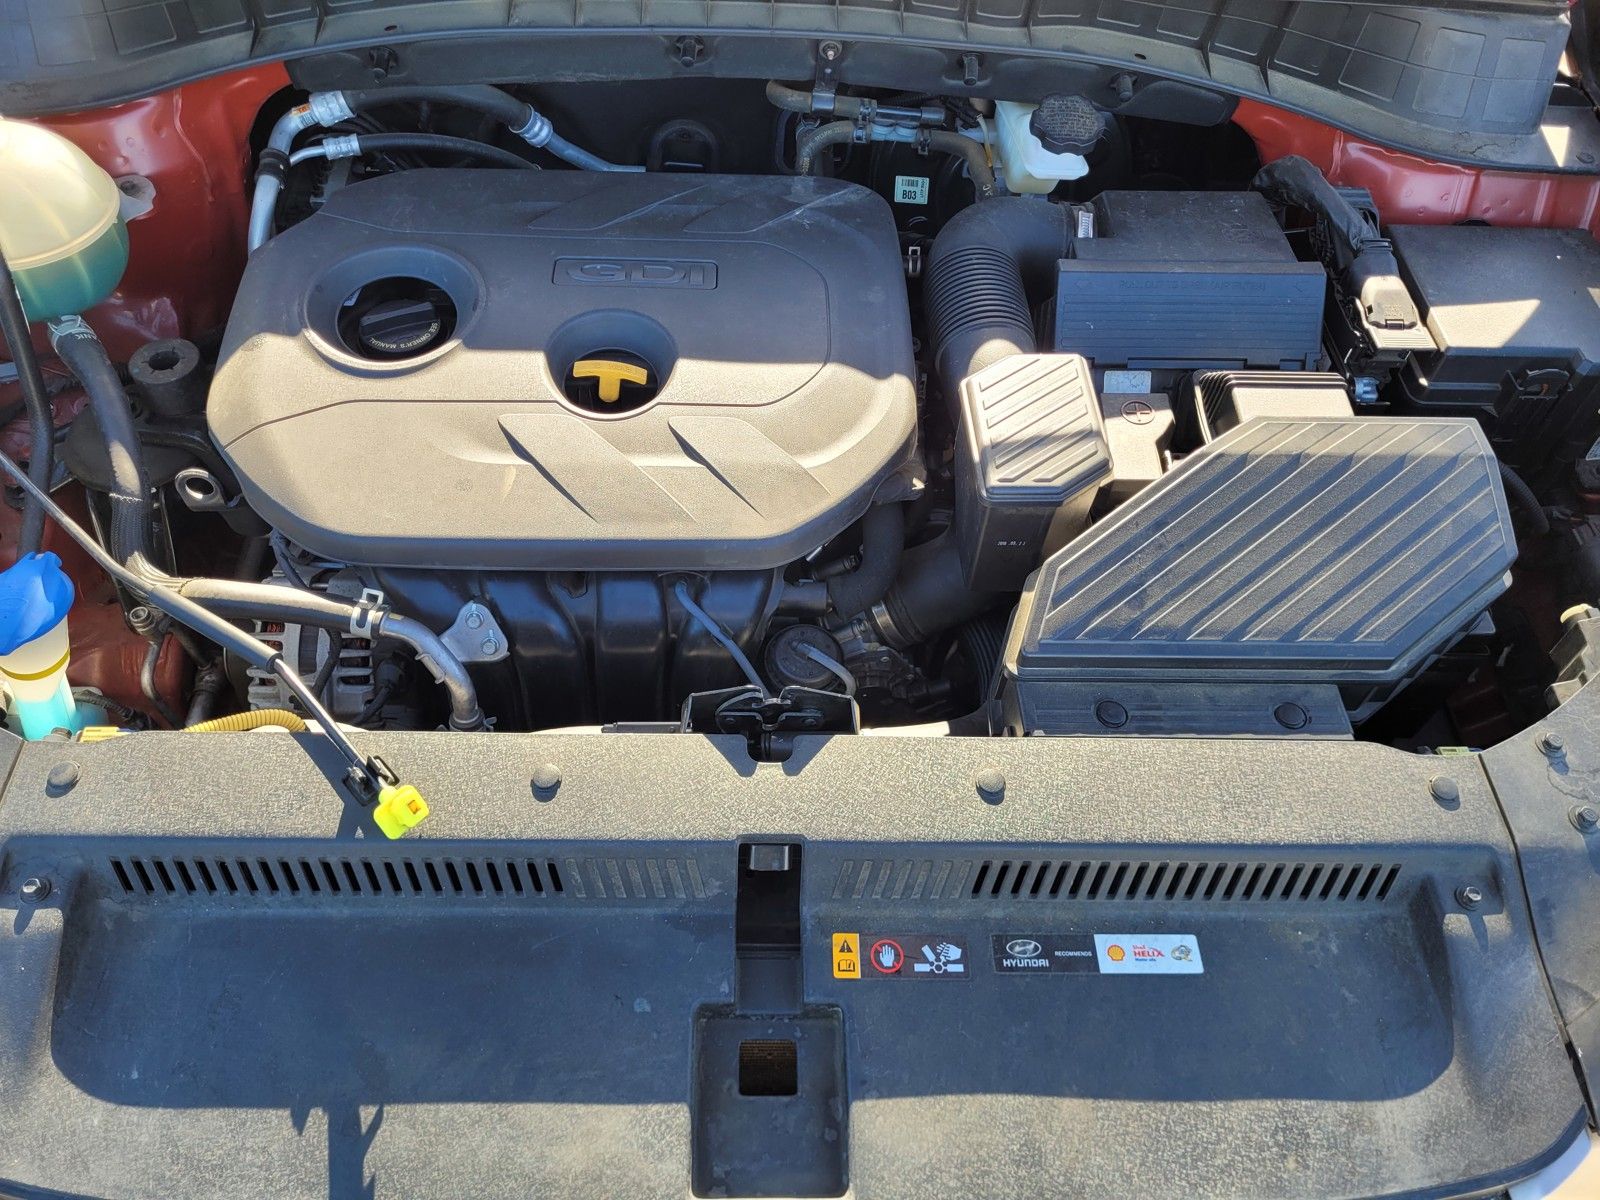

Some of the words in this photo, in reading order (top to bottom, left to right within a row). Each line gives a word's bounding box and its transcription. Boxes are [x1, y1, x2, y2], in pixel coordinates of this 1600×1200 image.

[902, 189, 917, 201] B03
[566, 263, 705, 286] GDI
[369, 337, 397, 350] MANUAL
[1133, 946, 1165, 958] HELIX
[1003, 958, 1049, 968] HYUNDAI
